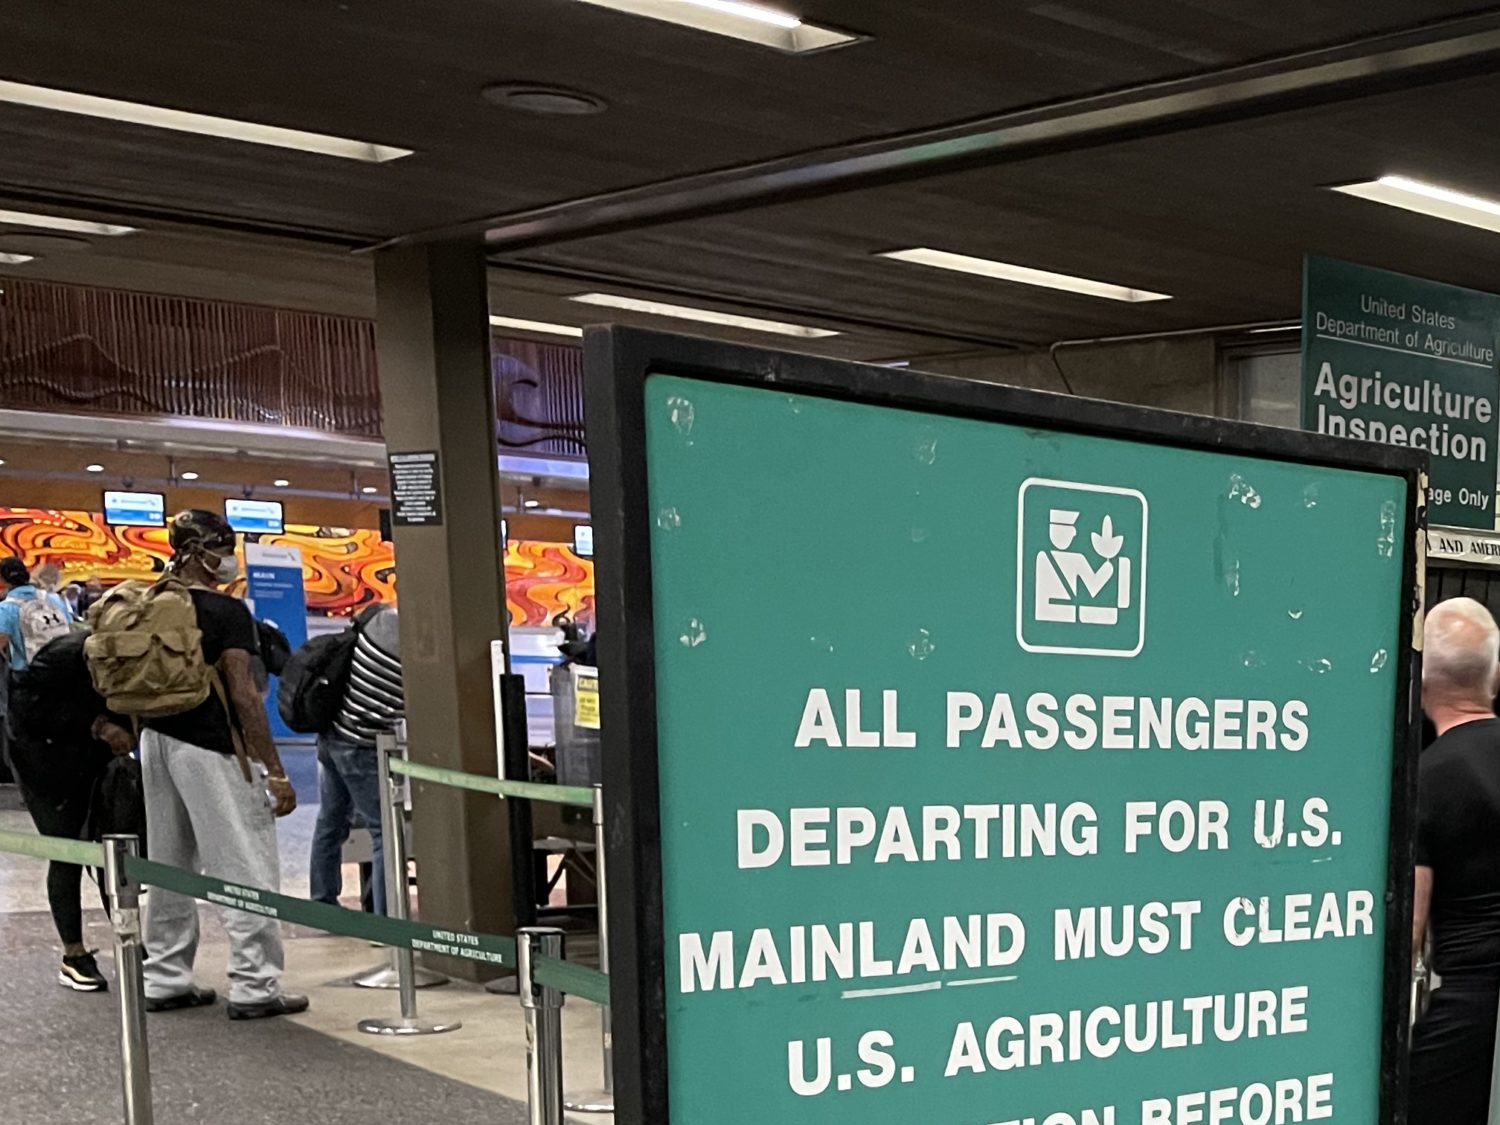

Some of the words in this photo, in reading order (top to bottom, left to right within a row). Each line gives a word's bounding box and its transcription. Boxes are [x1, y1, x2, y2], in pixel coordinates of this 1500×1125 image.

[1316, 311, 1400, 345] Department
[1405, 330, 1419, 348] of
[1424, 334, 1494, 362] Agriculture
[1361, 294, 1406, 320] United
[1411, 305, 1456, 330] States
[1314, 361, 1493, 424] Agriculture
[1318, 404, 1487, 462] Inspection
[1428, 487, 1452, 506] age
[1458, 487, 1489, 511] Only
[1440, 537, 1464, 553] AND
[794, 688, 917, 749] ALL
[946, 691, 1310, 752] PASSENGERS
[736, 802, 1099, 869] DEPARTING
[1124, 800, 1230, 854] FOR
[1253, 797, 1343, 849] U.S.
[678, 912, 1027, 993] MAINLAND
[1054, 900, 1201, 962] MUST
[1223, 890, 1375, 947] CLEAR
[787, 1028, 916, 1097] U.S.
[944, 985, 1310, 1079] AGRICULTURE
